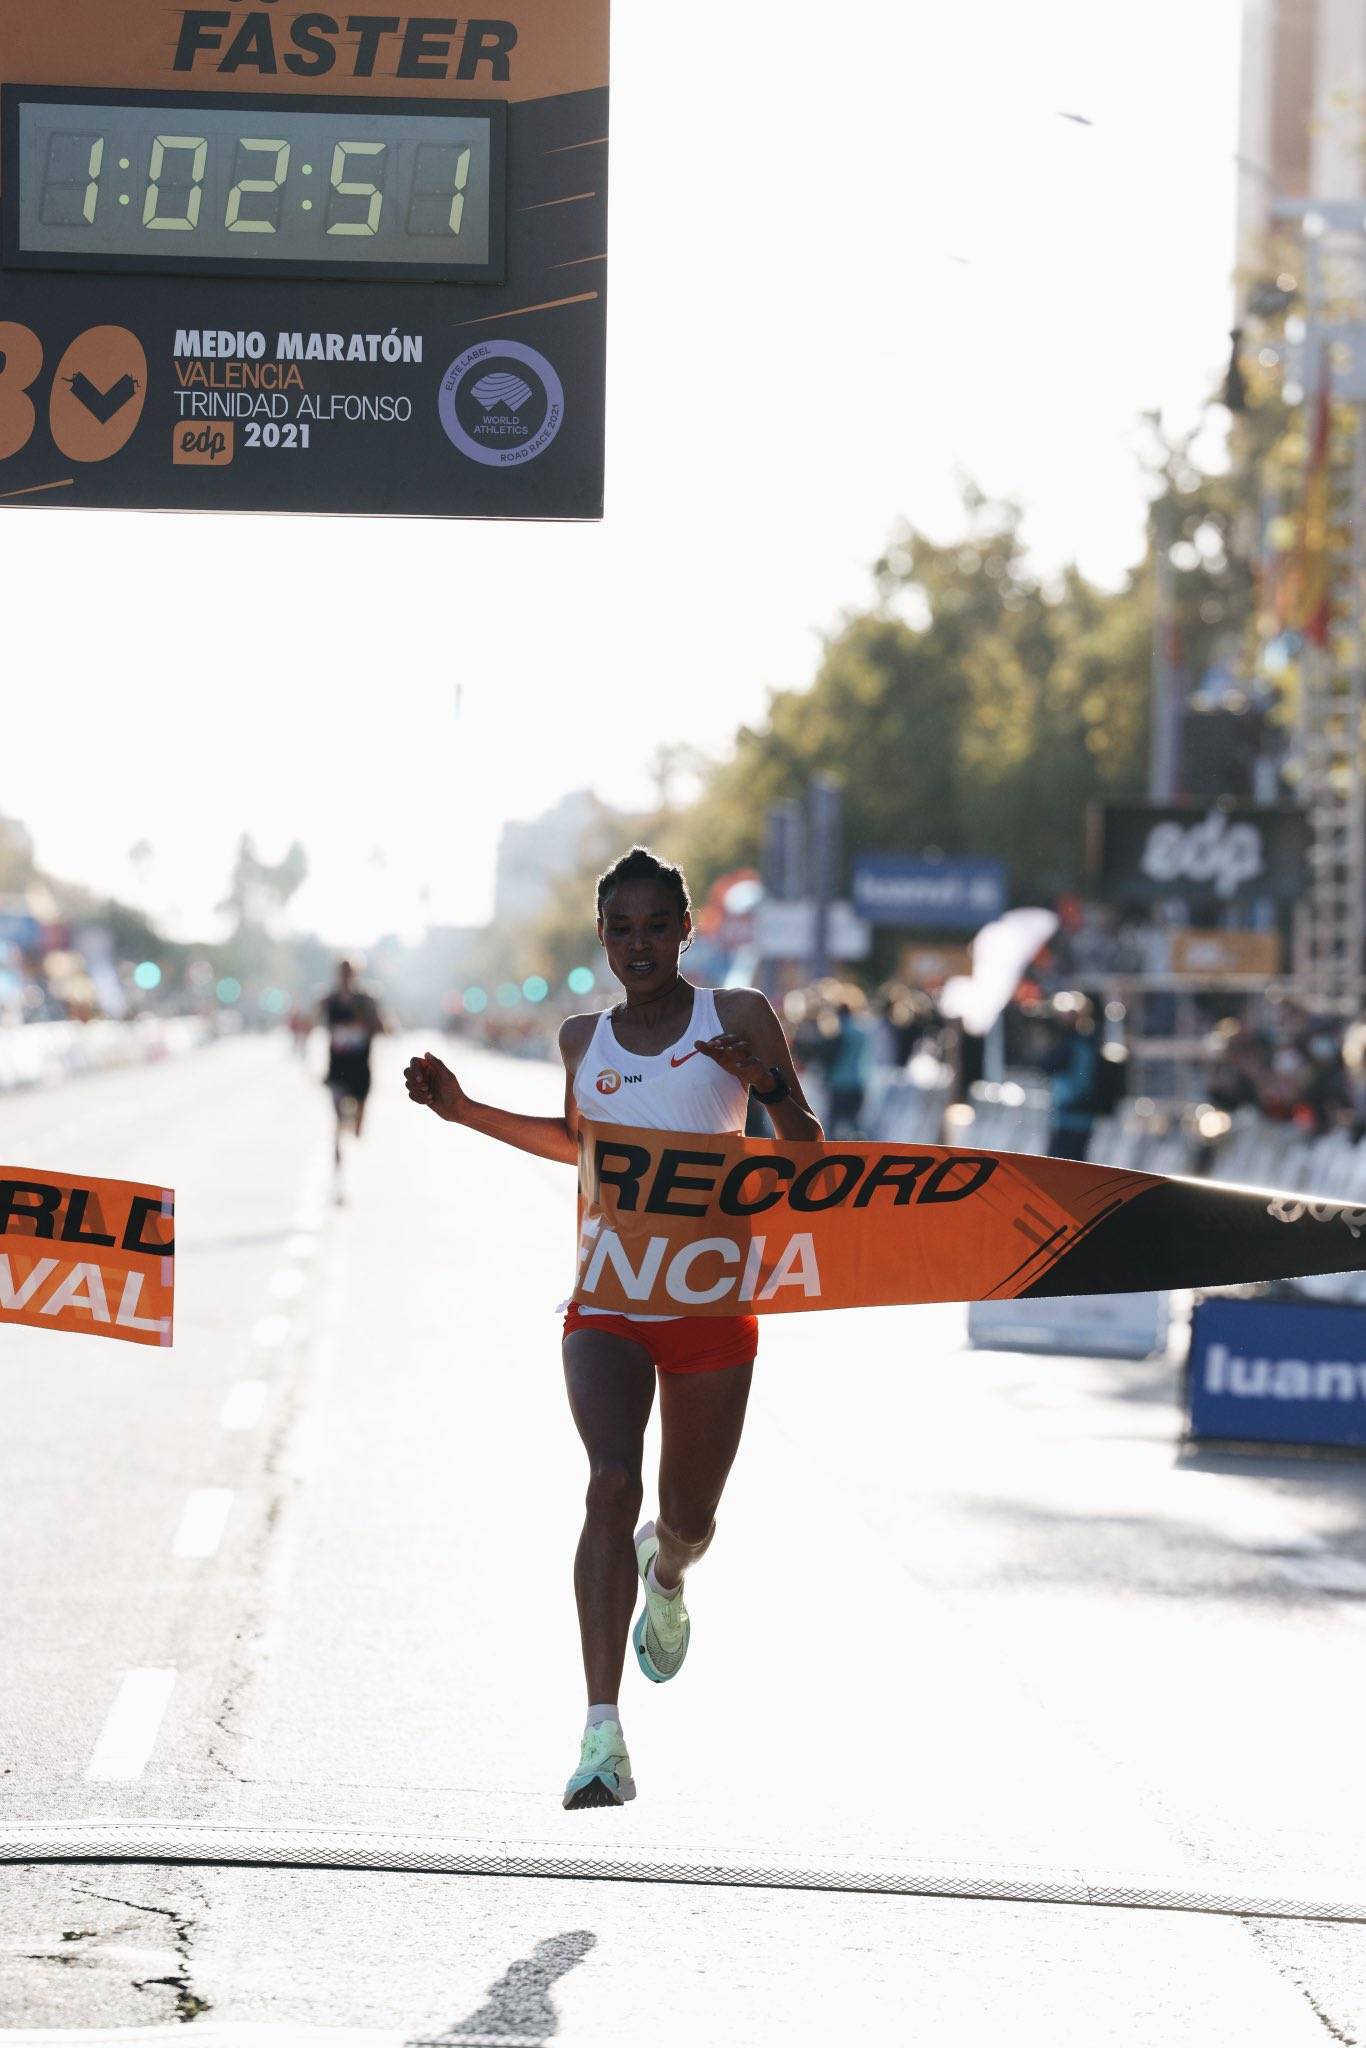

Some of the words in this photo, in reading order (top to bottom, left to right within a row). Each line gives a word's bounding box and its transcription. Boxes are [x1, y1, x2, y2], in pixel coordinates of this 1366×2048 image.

[172, 9, 518, 81] FASTER
[83, 135, 471, 237] 1:02:51
[173, 330, 266, 359] MEDIO
[276, 328, 423, 363] MARATÓN
[174, 361, 304, 390] VALENCIA
[445, 364, 463, 391] ELITE
[460, 345, 491, 367] LABEL
[173, 391, 288, 418] TRINIDAD
[296, 393, 411, 422] ALFONSO
[482, 415, 520, 425] WORLD
[180, 426, 226, 460] edp
[244, 422, 310, 448] 2021
[473, 425, 529, 435] ATHLETICS
[500, 449, 529, 463] ROAD
[528, 430, 552, 452] RACE
[547, 403, 560, 429] 2021
[624, 1074, 642, 1084] NN
[594, 1140, 996, 1218] RECORD
[1205, 1342, 1366, 1402] luan
